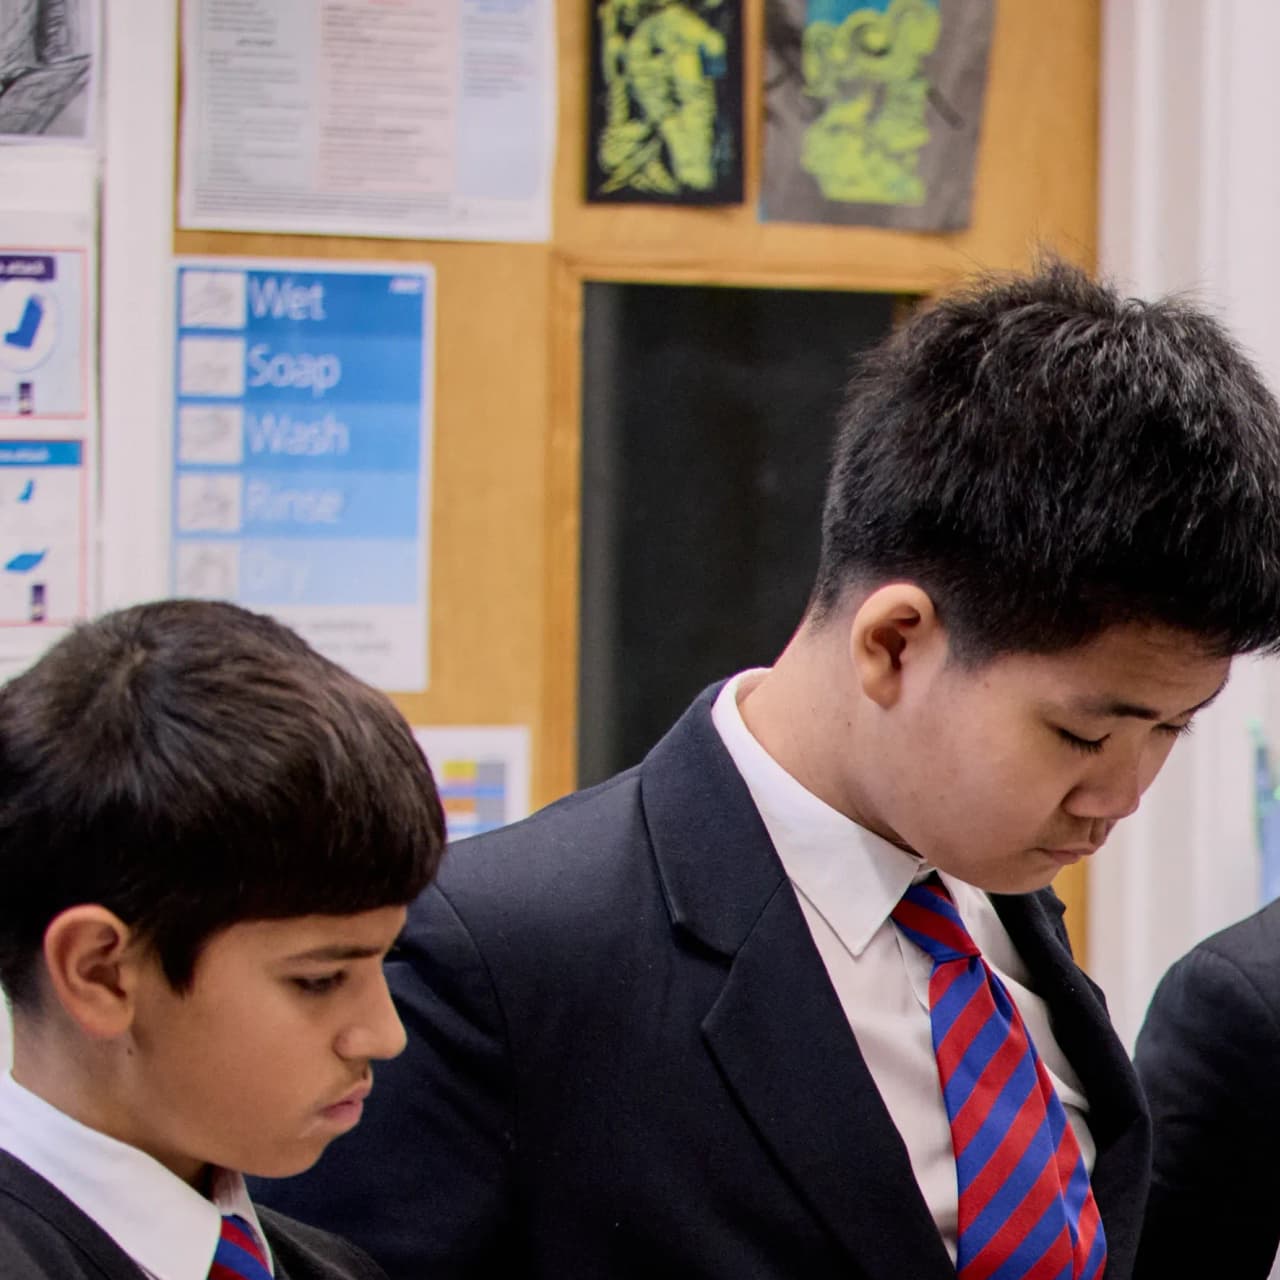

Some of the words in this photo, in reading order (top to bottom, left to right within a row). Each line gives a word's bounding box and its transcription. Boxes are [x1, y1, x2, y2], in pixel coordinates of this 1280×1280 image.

[249, 276, 326, 320] Wet
[248, 344, 342, 396] Soap
[247, 413, 350, 456] Wash
[246, 481, 344, 524] Rinse
